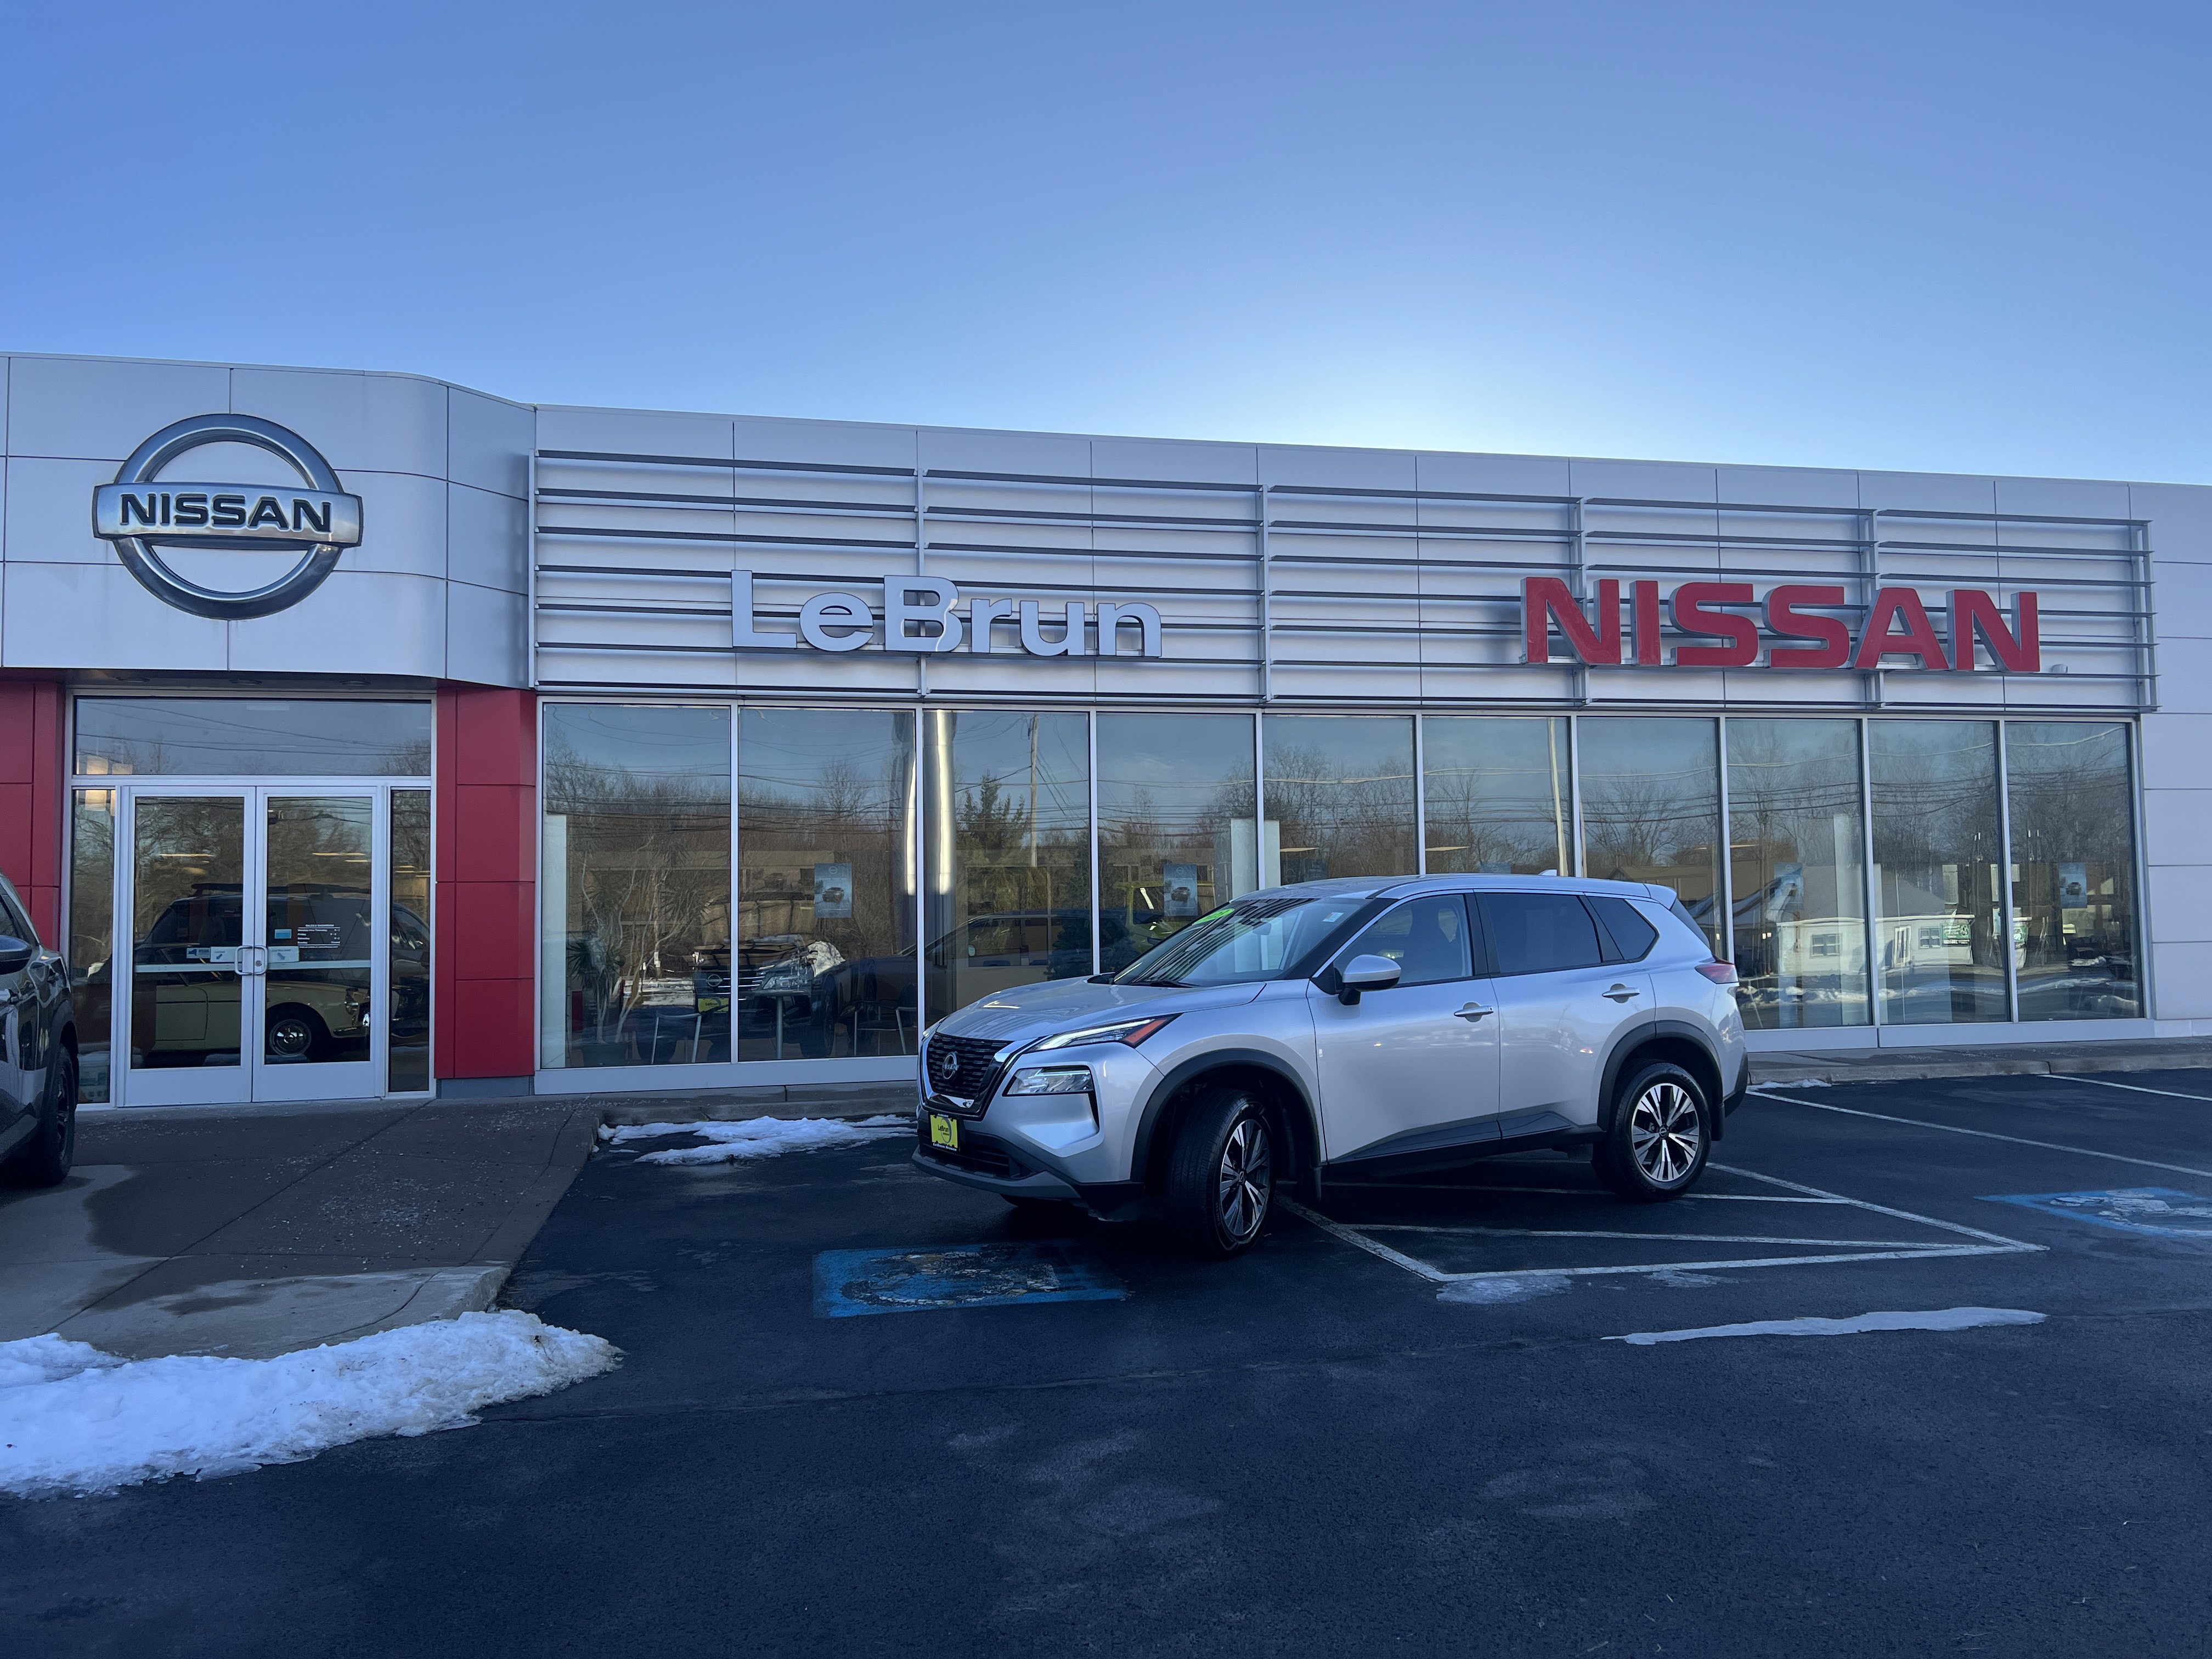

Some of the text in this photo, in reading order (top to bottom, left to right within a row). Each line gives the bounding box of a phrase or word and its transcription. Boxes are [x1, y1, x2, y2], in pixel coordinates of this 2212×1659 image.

[120, 493, 331, 532] NISSAN
[731, 569, 2040, 673] LeBrun NISSAN
